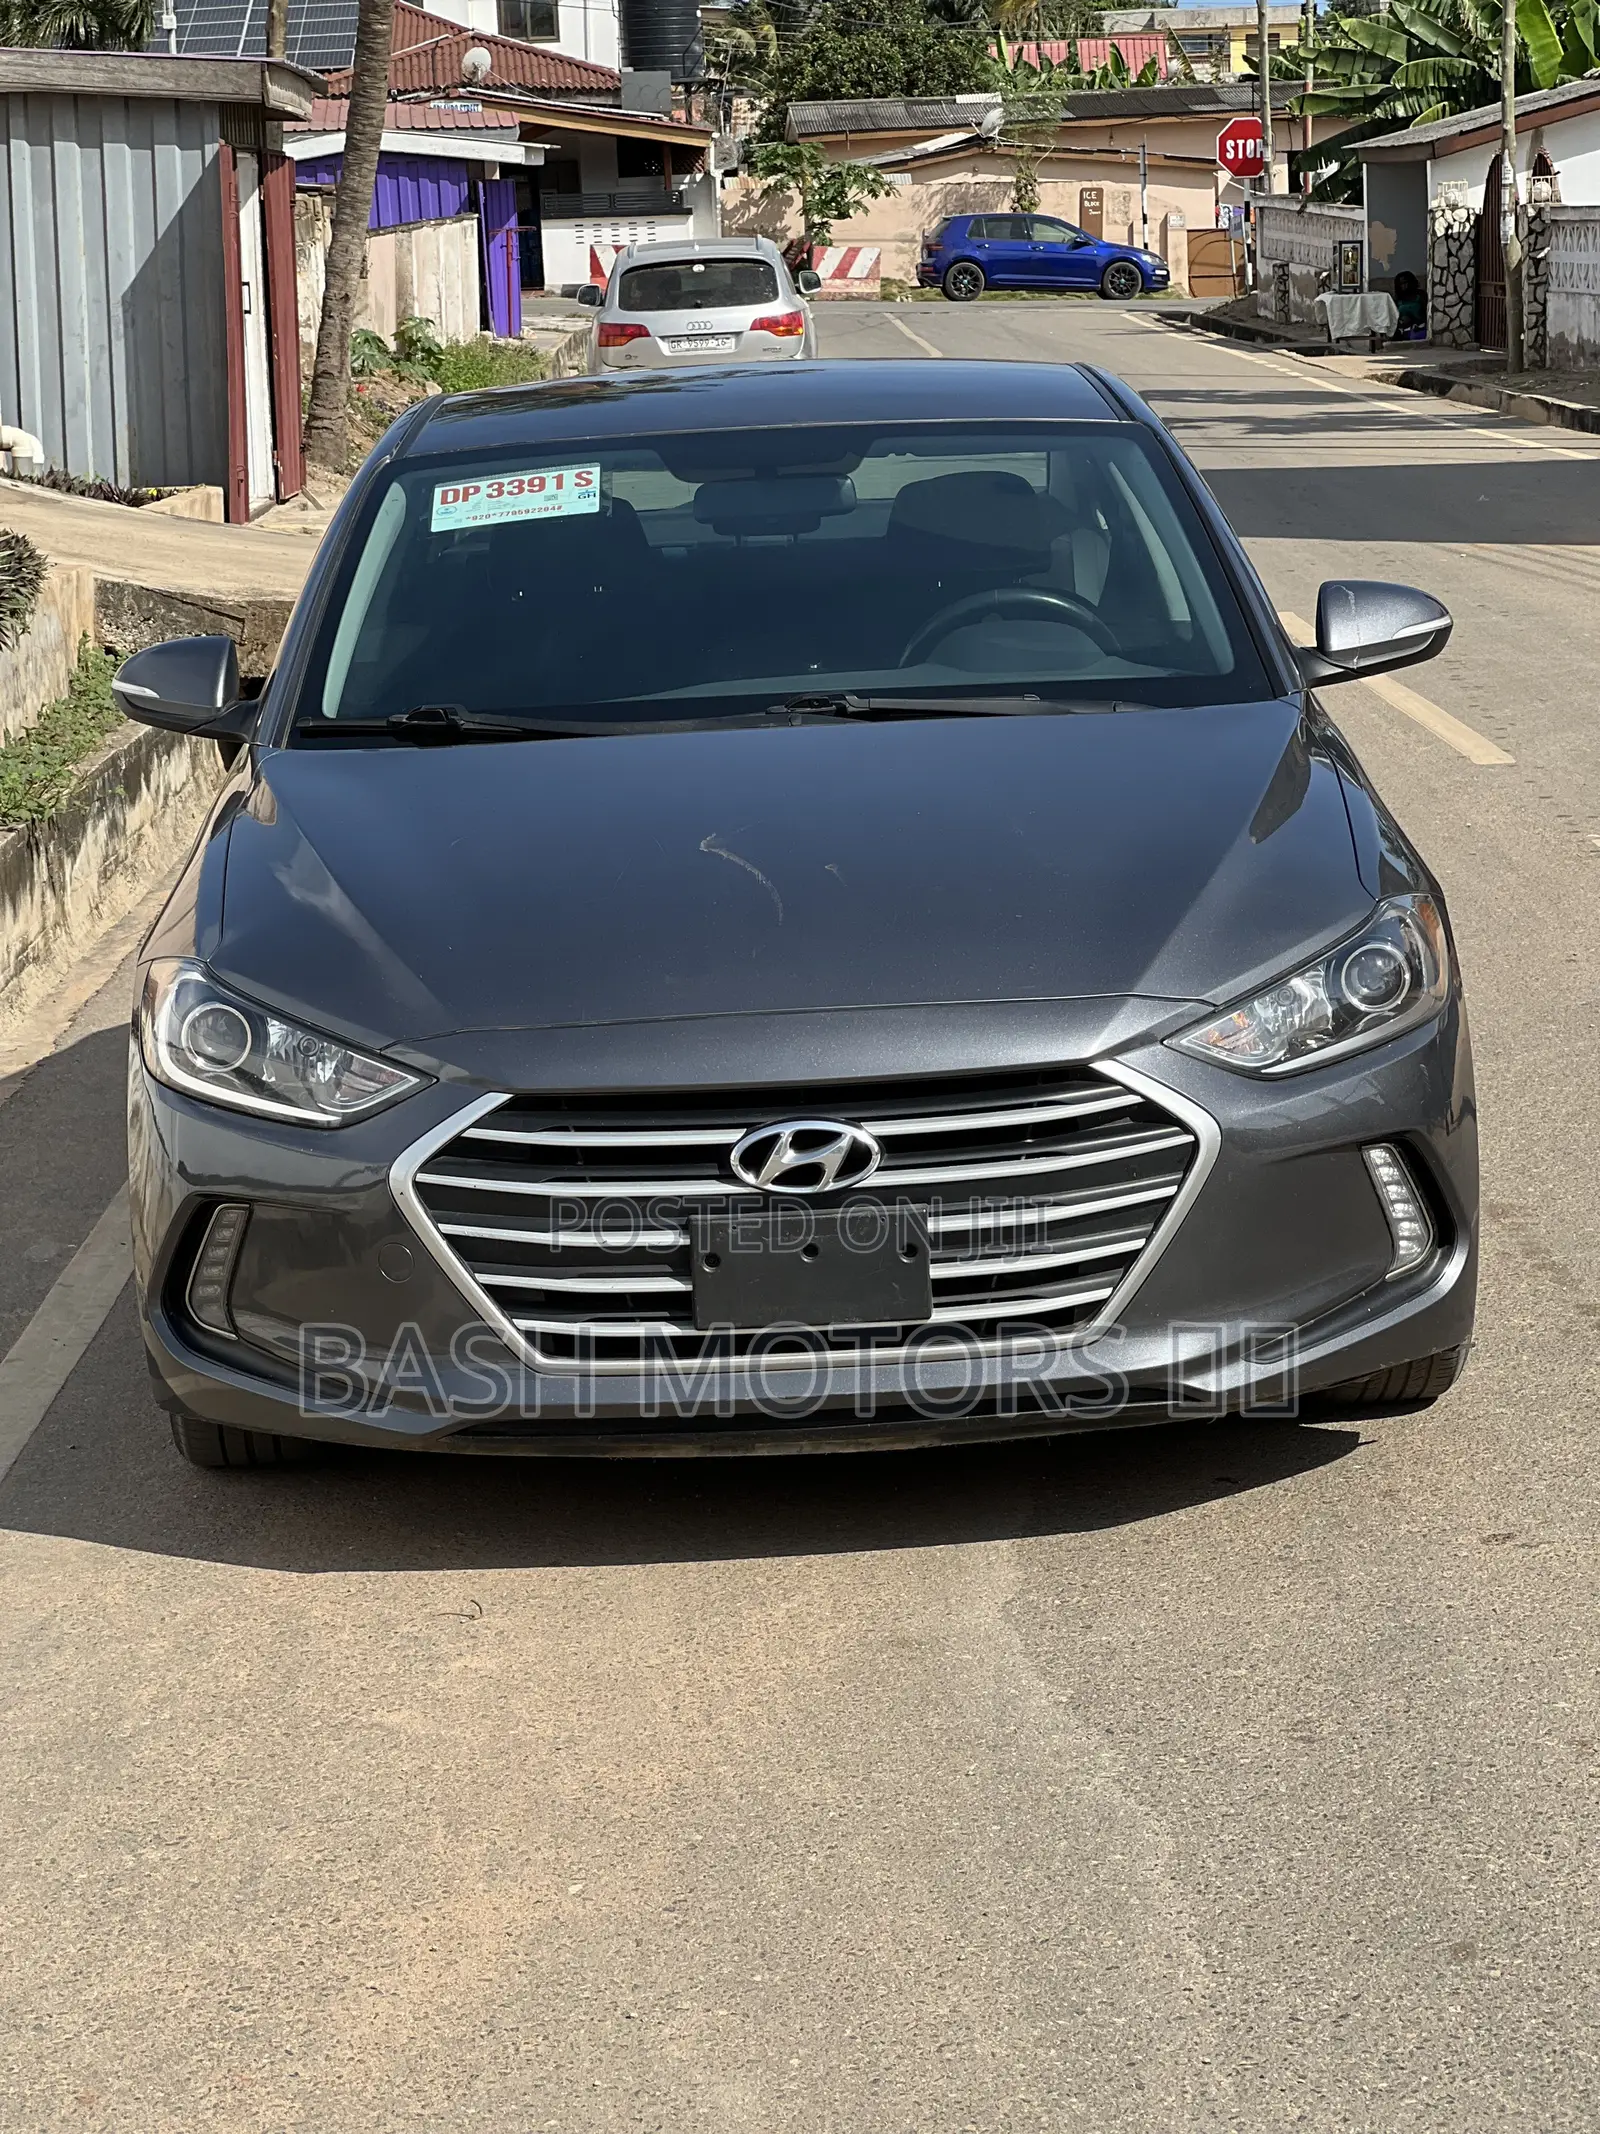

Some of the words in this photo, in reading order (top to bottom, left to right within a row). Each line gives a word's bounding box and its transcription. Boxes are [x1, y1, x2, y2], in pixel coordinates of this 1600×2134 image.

[1083, 191, 1097, 199] ICE
[440, 485, 481, 505] DP
[486, 473, 564, 499] 3391
[574, 470, 593, 487] S
